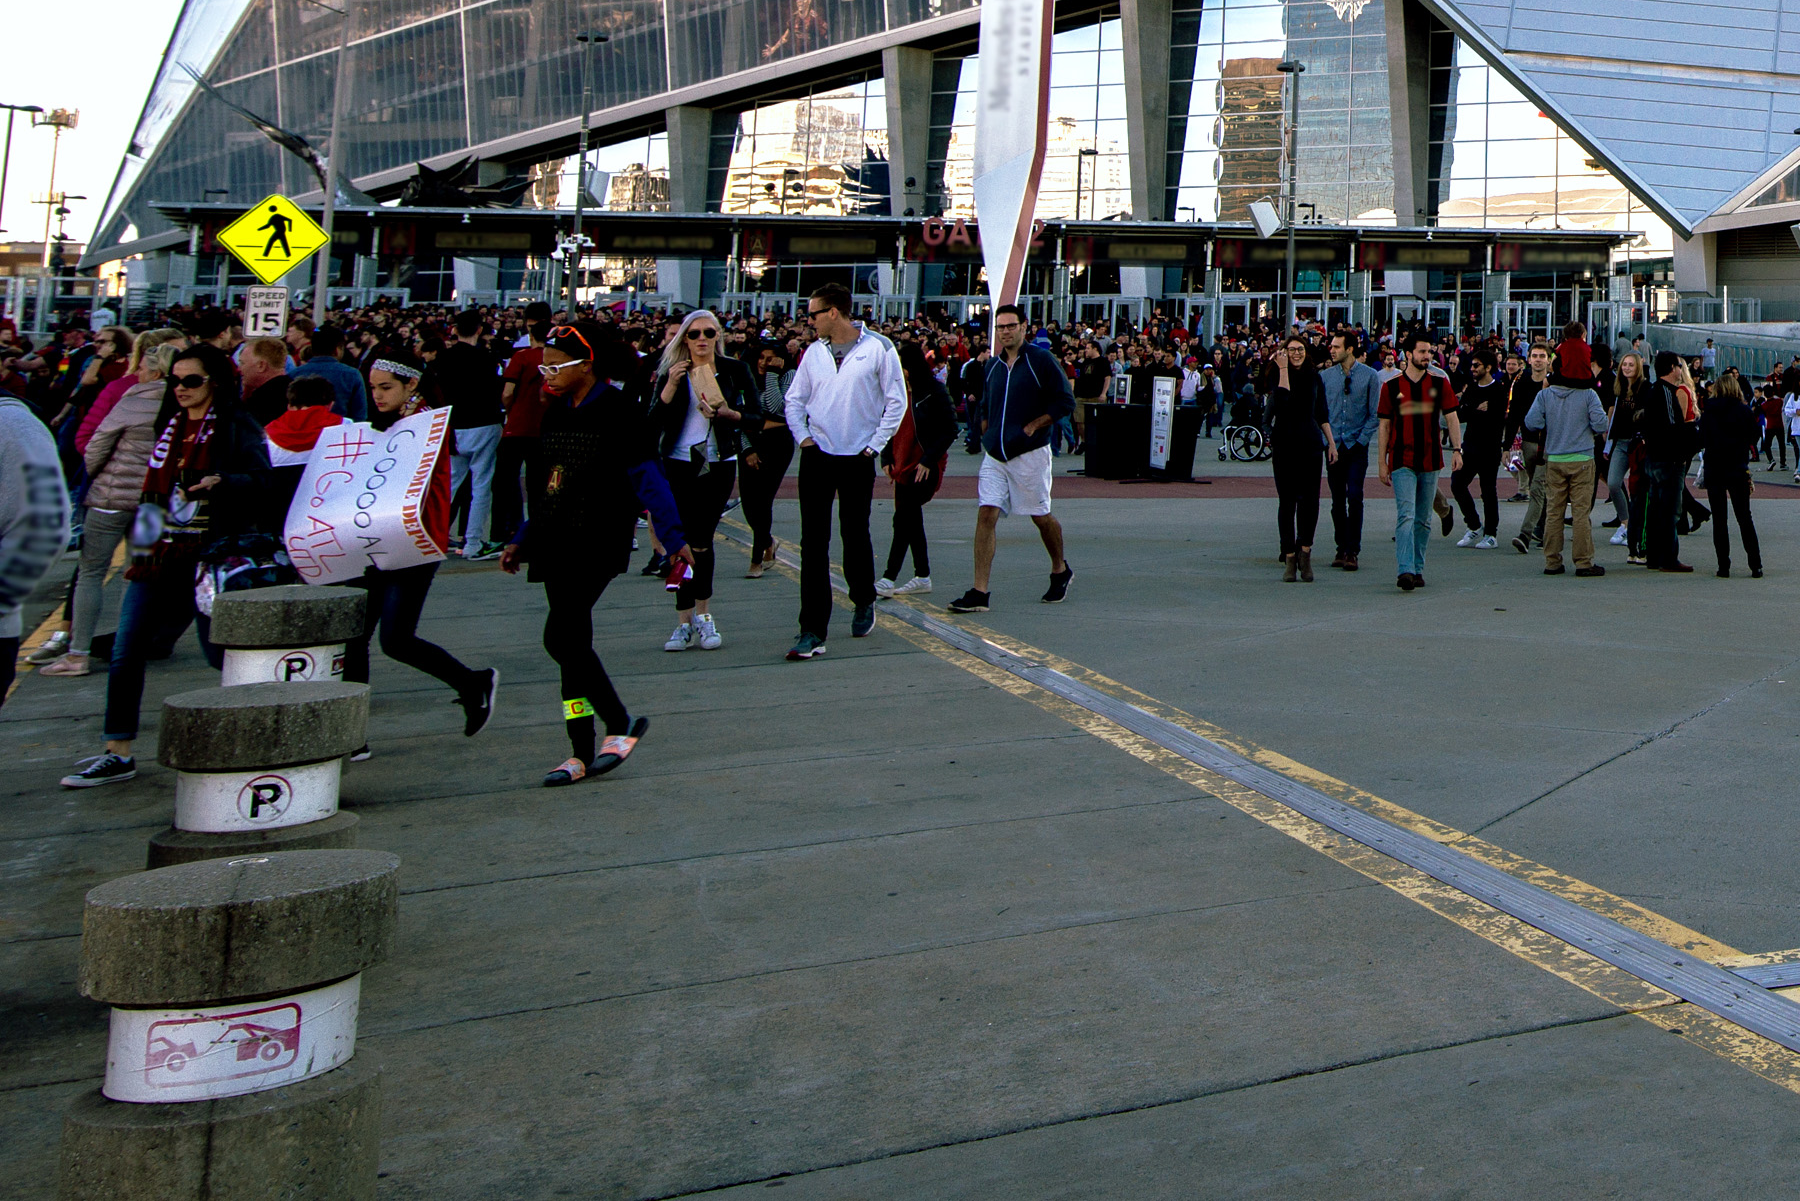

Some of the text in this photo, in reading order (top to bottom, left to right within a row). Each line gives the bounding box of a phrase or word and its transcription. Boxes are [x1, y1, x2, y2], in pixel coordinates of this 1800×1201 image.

[922, 217, 980, 247] GA
[251, 313, 280, 331] 15
[402, 409, 449, 556] THE HOME DEPOT
[284, 657, 307, 681] P
[570, 701, 585, 715] C
[250, 783, 283, 818] P
